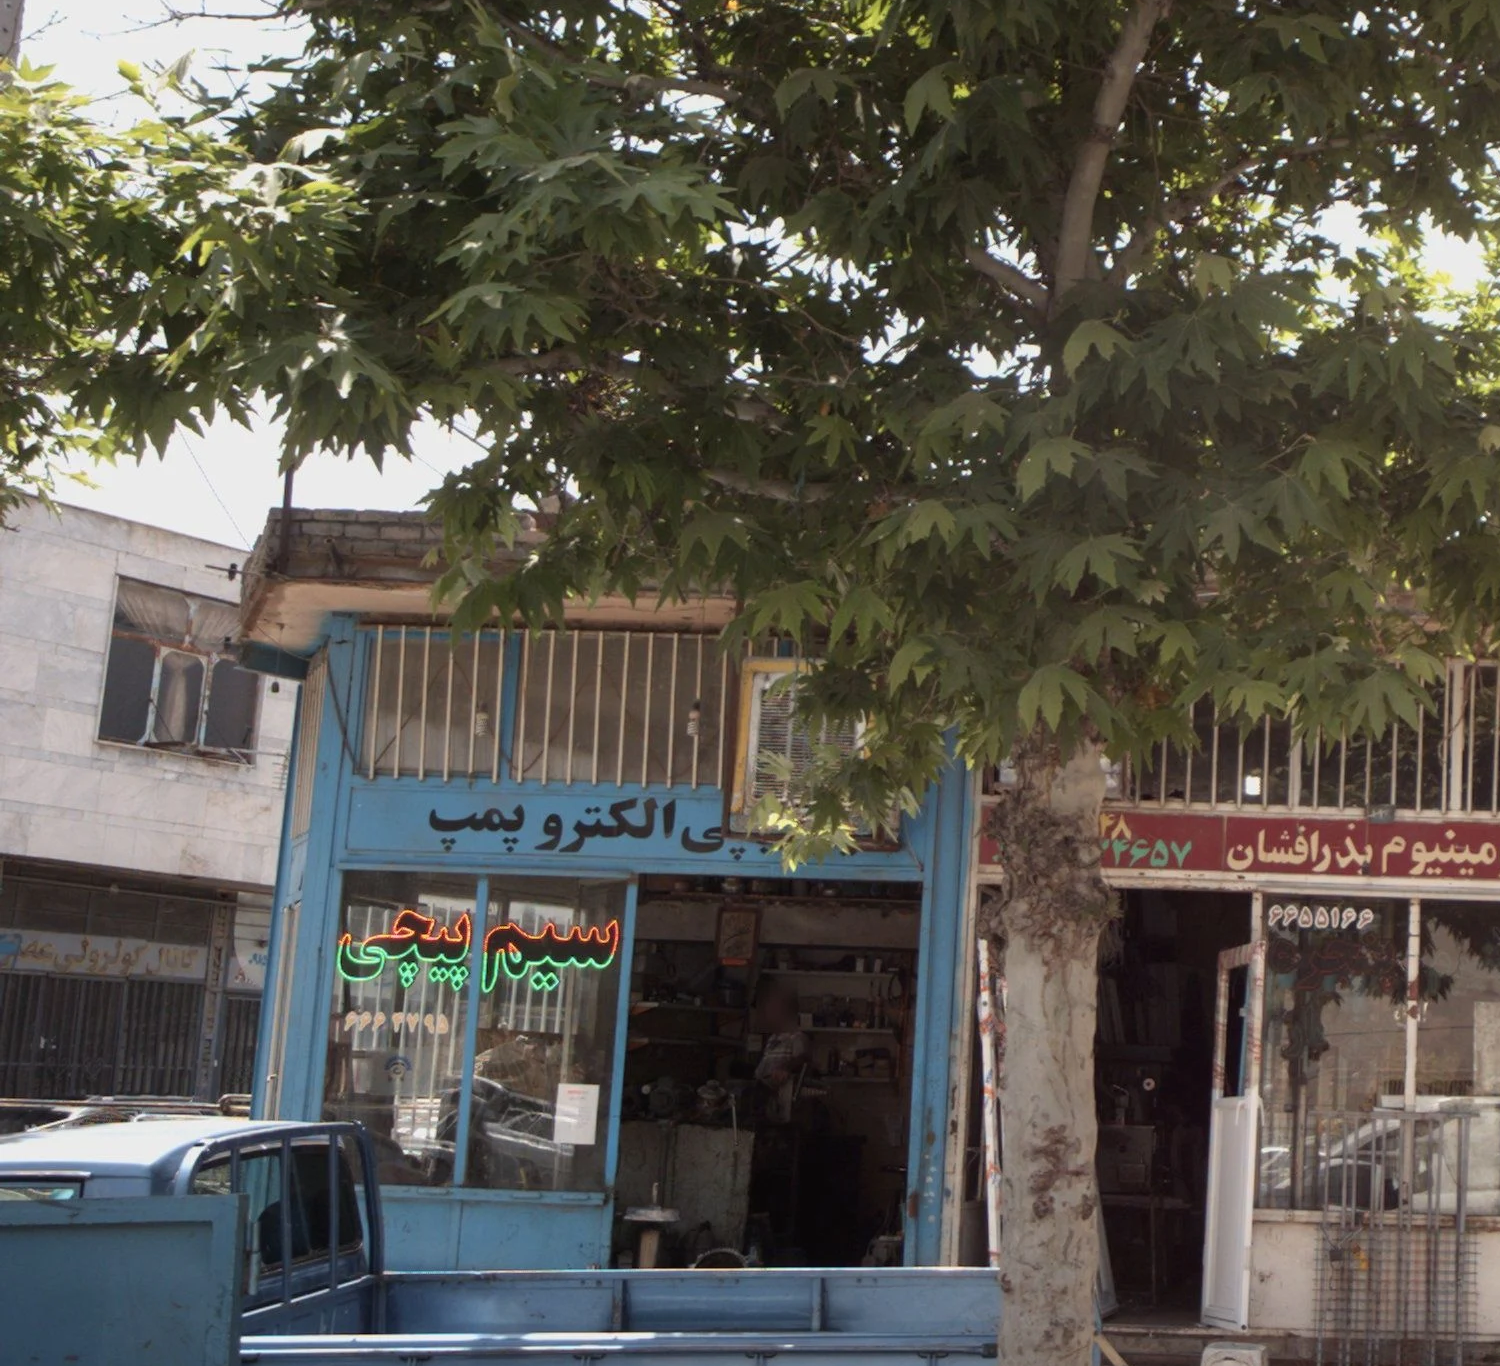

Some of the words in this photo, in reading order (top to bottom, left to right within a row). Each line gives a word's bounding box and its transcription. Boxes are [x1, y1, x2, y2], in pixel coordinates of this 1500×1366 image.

[428, 802, 525, 853] پمپ
[533, 796, 677, 854] الکترو
[1267, 904, 1375, 931] ۶۶۵۵۱۶۶
[20, 939, 55, 962] عص
[336, 908, 472, 992] پیچی
[480, 918, 620, 994] سیم
